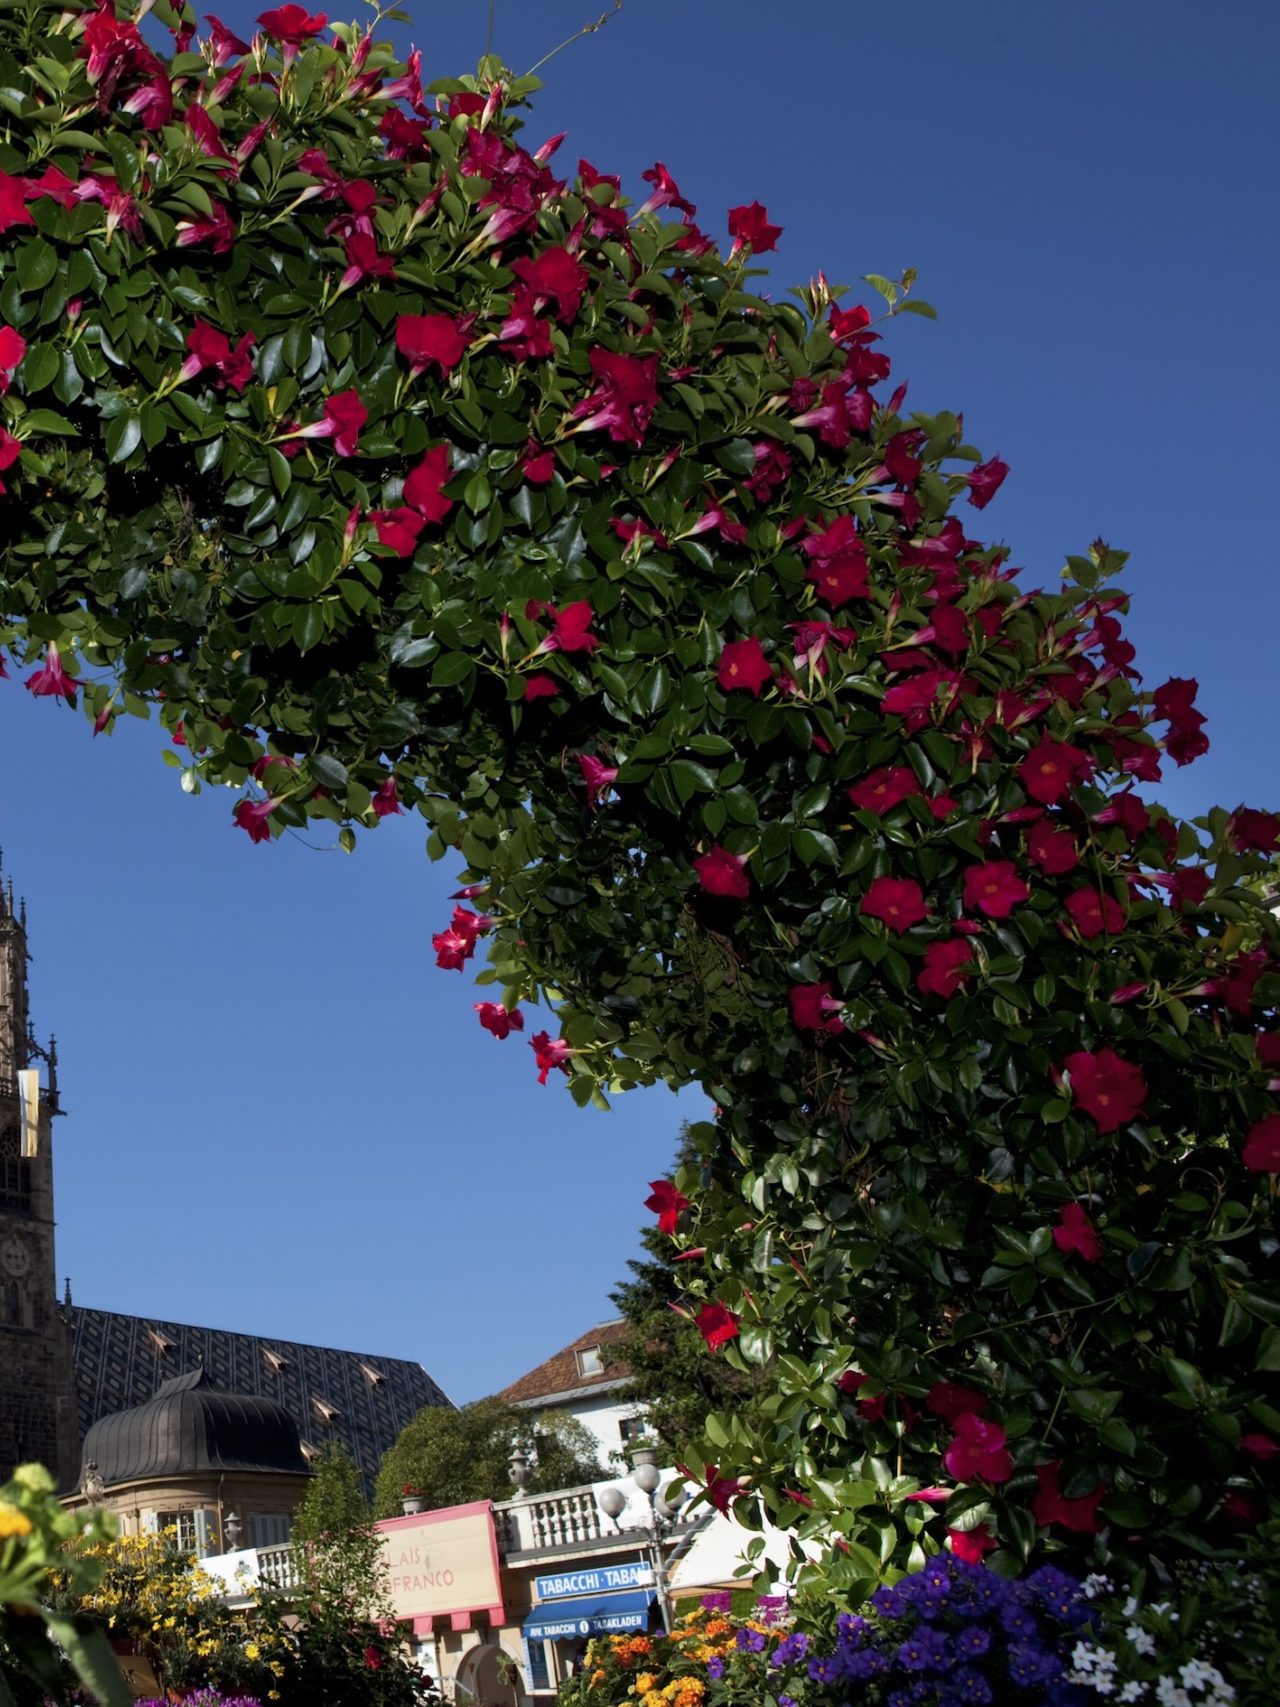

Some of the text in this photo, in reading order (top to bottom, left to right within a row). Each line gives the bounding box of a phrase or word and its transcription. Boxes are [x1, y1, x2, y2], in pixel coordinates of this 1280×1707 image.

[540, 1574, 599, 1595] TABACCHI
[544, 1623, 576, 1636] TABACCHI
[593, 1615, 642, 1630] TABAKLADEN
